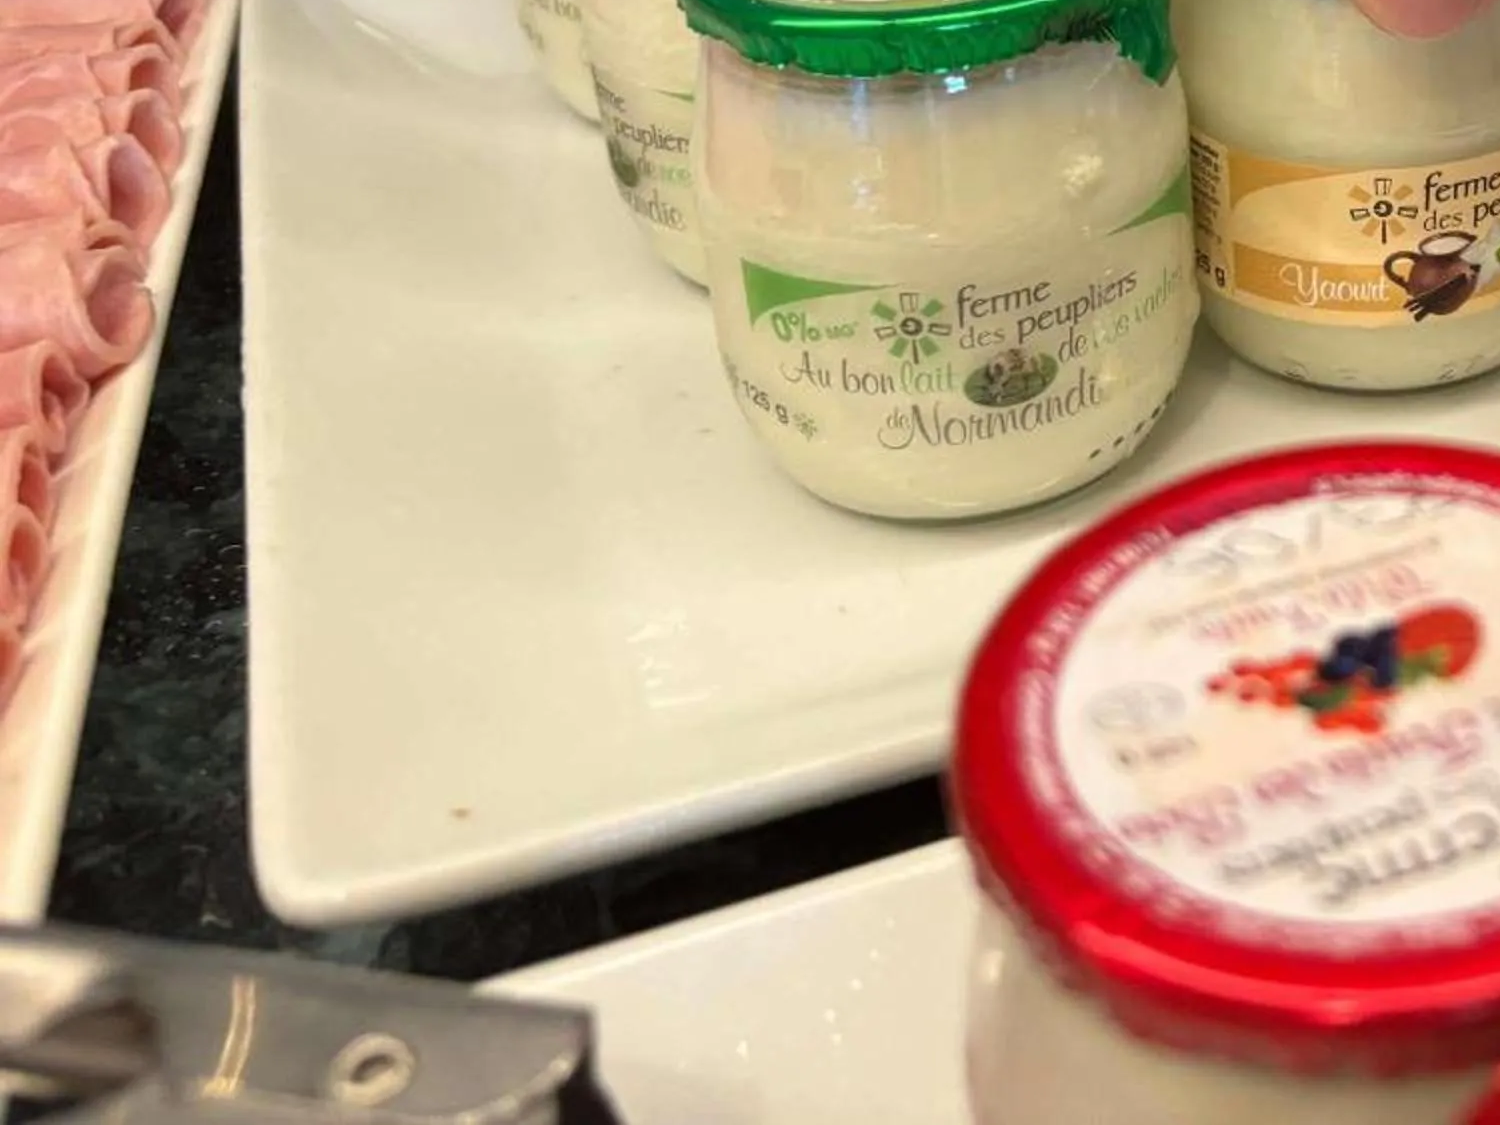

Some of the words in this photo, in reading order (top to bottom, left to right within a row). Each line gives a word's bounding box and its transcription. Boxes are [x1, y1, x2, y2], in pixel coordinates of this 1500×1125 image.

[1423, 205, 1463, 232] des
[957, 281, 1051, 328] ferme
[1278, 262, 1390, 308] Yaourt
[771, 311, 822, 343] 0%
[959, 326, 1006, 350] des
[1017, 270, 1138, 345] peupliers
[779, 350, 831, 392] Au
[841, 358, 896, 395] bon
[900, 360, 958, 396] lait
[1058, 327, 1089, 363] de
[742, 379, 770, 412] 125
[775, 403, 789, 425] g
[878, 367, 1104, 451] Normandi
